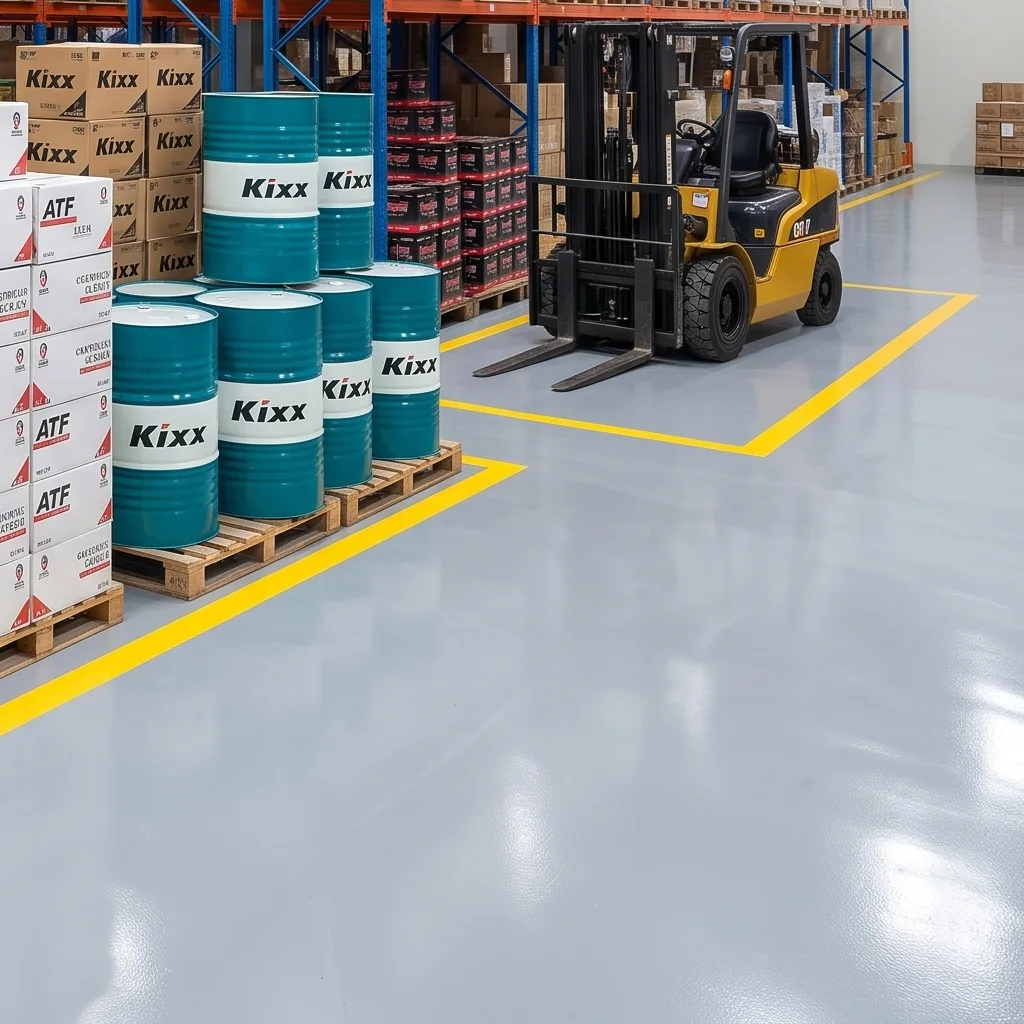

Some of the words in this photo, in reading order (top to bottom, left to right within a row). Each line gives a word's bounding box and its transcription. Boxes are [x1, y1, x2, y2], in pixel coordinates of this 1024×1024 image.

[26, 69, 75, 89] Kixx
[97, 70, 139, 89] Kixx
[157, 69, 195, 86] Kixx
[96, 137, 135, 156] Kixx
[157, 131, 193, 150] Kixx
[27, 142, 78, 164] Kixx
[241, 178, 309, 199] Kixx
[323, 170, 372, 190] Kixx
[42, 197, 75, 219] ATF
[113, 202, 134, 218] xx
[153, 194, 189, 213] Kixx
[113, 261, 140, 280] ixx
[159, 253, 195, 273] Kixx
[382, 355, 437, 376] Kixx
[323, 377, 371, 399] Kixx
[231, 400, 307, 423] Kixx
[36, 413, 70, 441] ATF
[129, 423, 207, 448] Kixx
[36, 483, 70, 514] ATF
